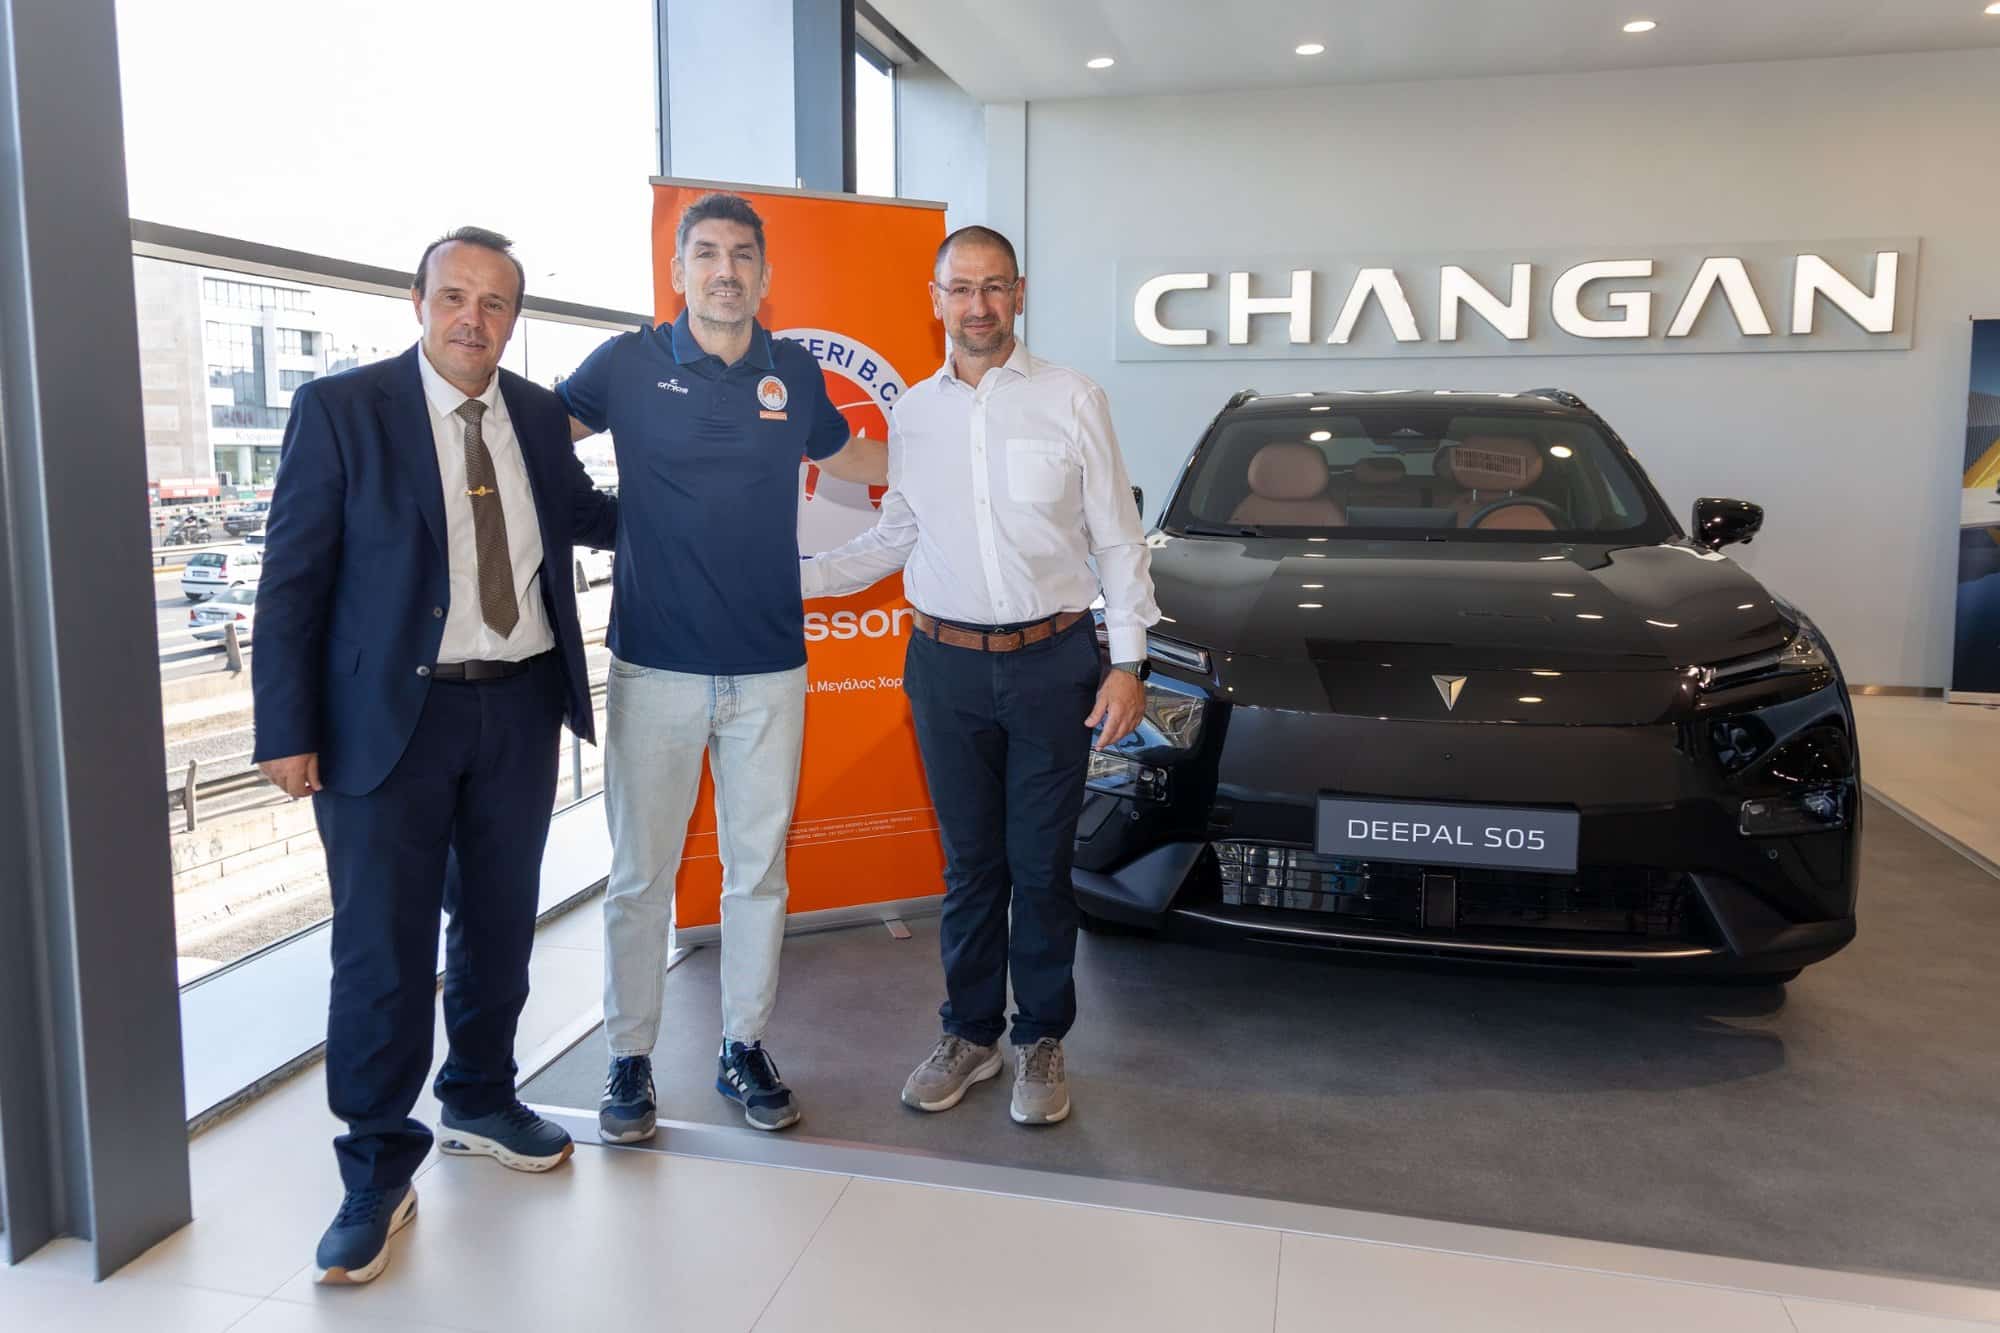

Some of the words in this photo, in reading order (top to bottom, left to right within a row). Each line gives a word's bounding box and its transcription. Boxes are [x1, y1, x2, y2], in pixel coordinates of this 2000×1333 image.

[1134, 251, 1898, 345] CHANGAN
[817, 676, 876, 694] Μεγάλος
[1347, 819, 1473, 847] DEEPAL
[1484, 827, 1545, 851] S05
